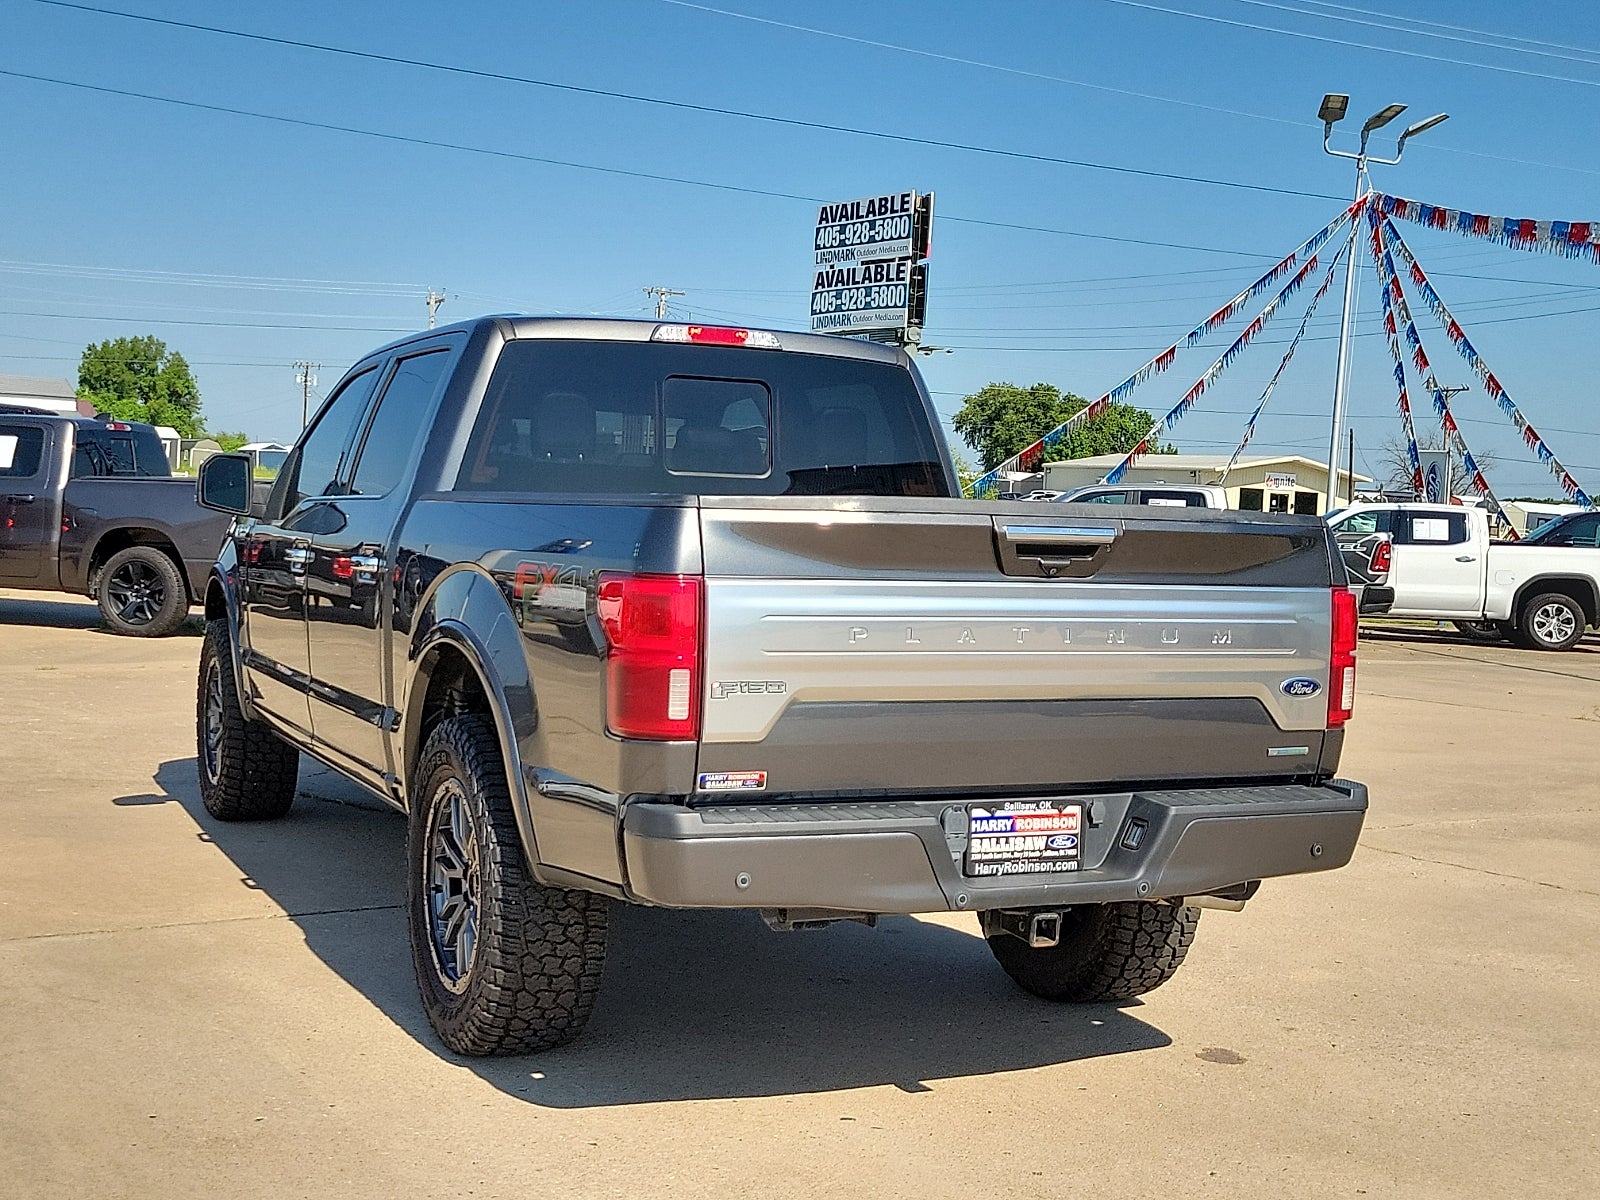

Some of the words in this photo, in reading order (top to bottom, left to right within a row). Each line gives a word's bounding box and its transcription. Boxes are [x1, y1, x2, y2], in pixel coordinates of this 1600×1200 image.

[818, 193, 910, 225] AVAILABLE
[816, 216, 909, 248] 405-928-5800
[814, 262, 906, 290] AVAILABLE
[812, 285, 905, 313] 405-928-5800
[513, 559, 583, 602] FX4
[849, 625, 1234, 645] PLATINUM
[1039, 800, 1053, 809] OK
[972, 818, 1014, 832] HARRY
[1015, 816, 1077, 831] ROBINSON
[971, 836, 1048, 852] SALLISAW
[975, 860, 1077, 876] HarryRobinson.com
